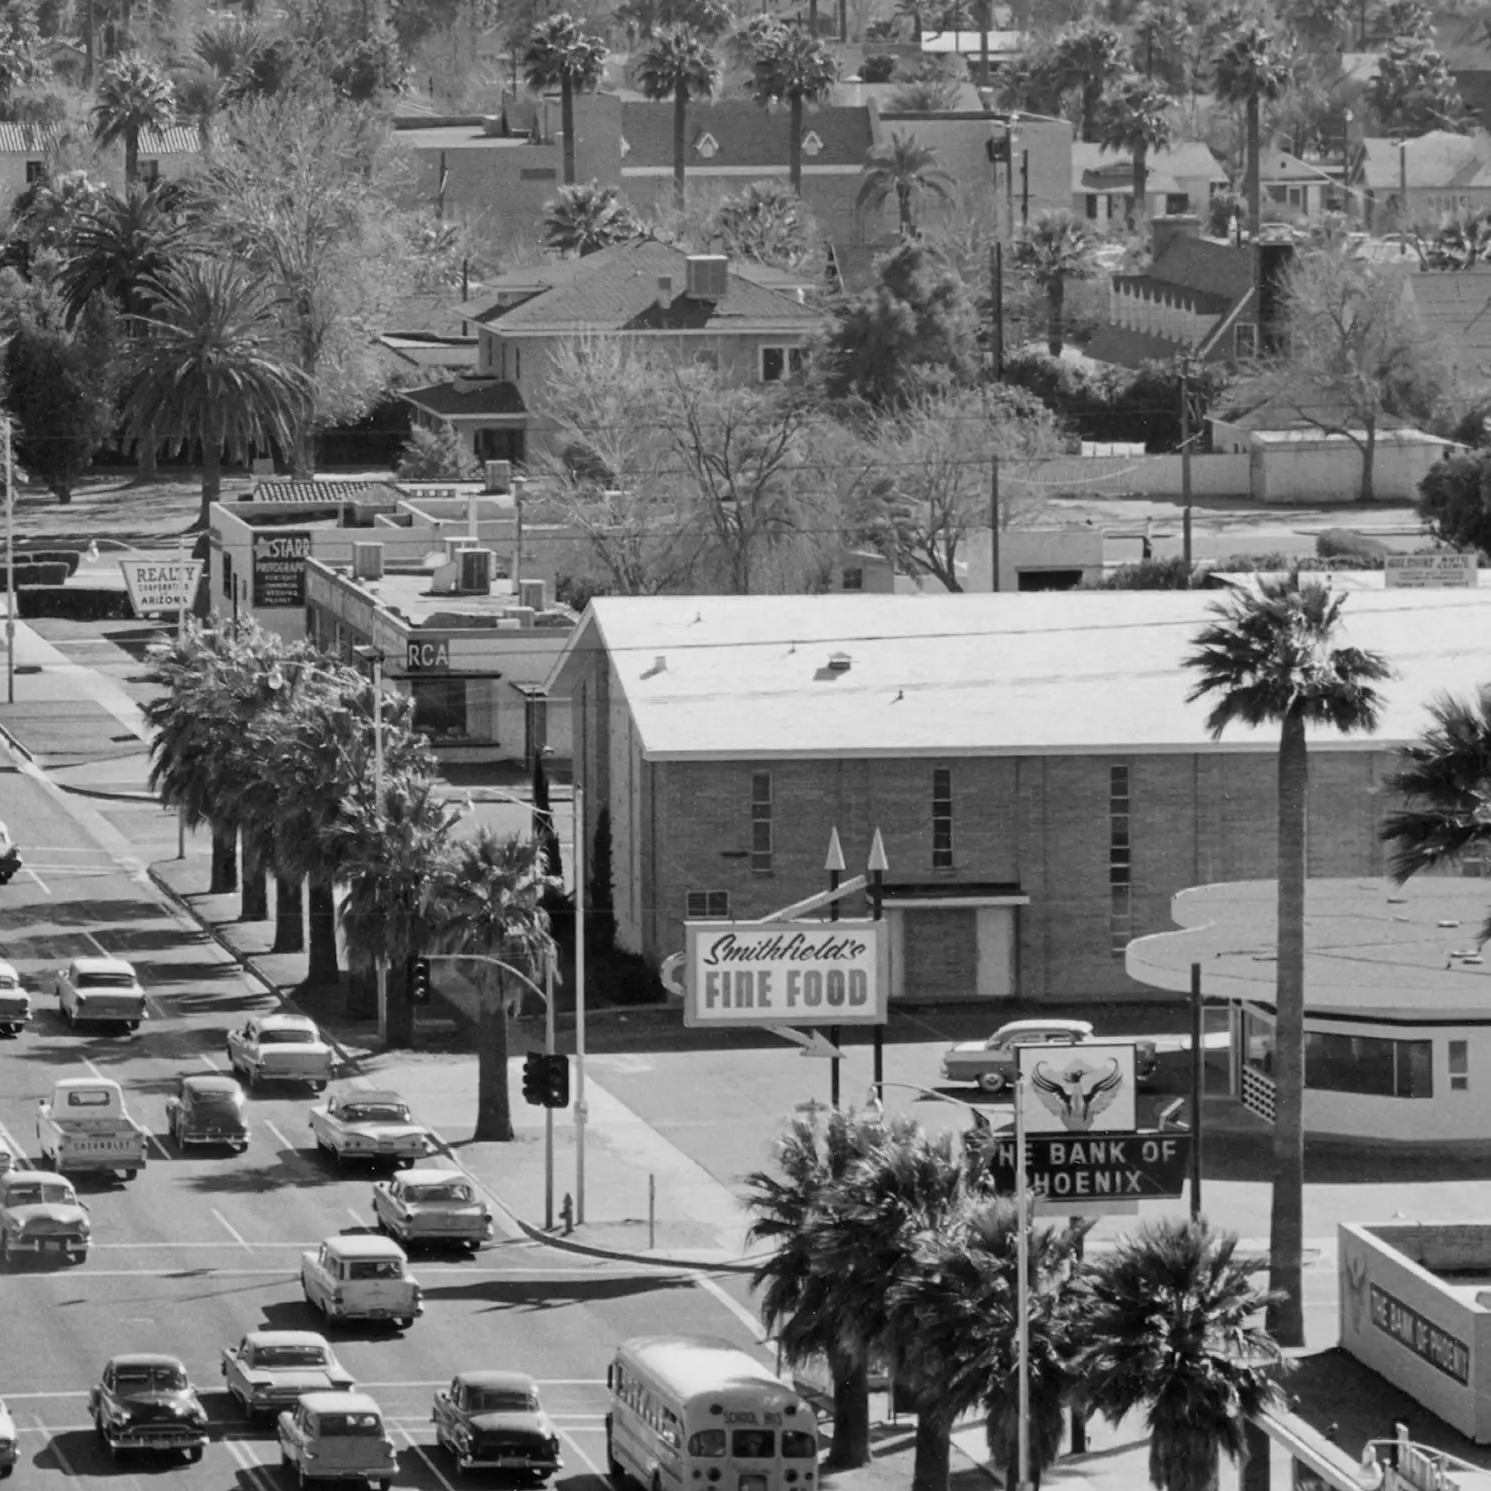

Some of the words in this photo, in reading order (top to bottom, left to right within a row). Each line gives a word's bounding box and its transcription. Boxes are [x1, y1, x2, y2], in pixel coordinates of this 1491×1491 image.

[408, 644, 449, 666] RCA
[703, 932, 867, 967] Smithfield's
[705, 971, 773, 1010] FINE
[785, 969, 868, 1008] FOOD
[997, 1142, 1034, 1167] HE
[1049, 1141, 1126, 1166] BANK
[1141, 1140, 1177, 1164] OF
[1025, 1170, 1142, 1198] HOENIX
